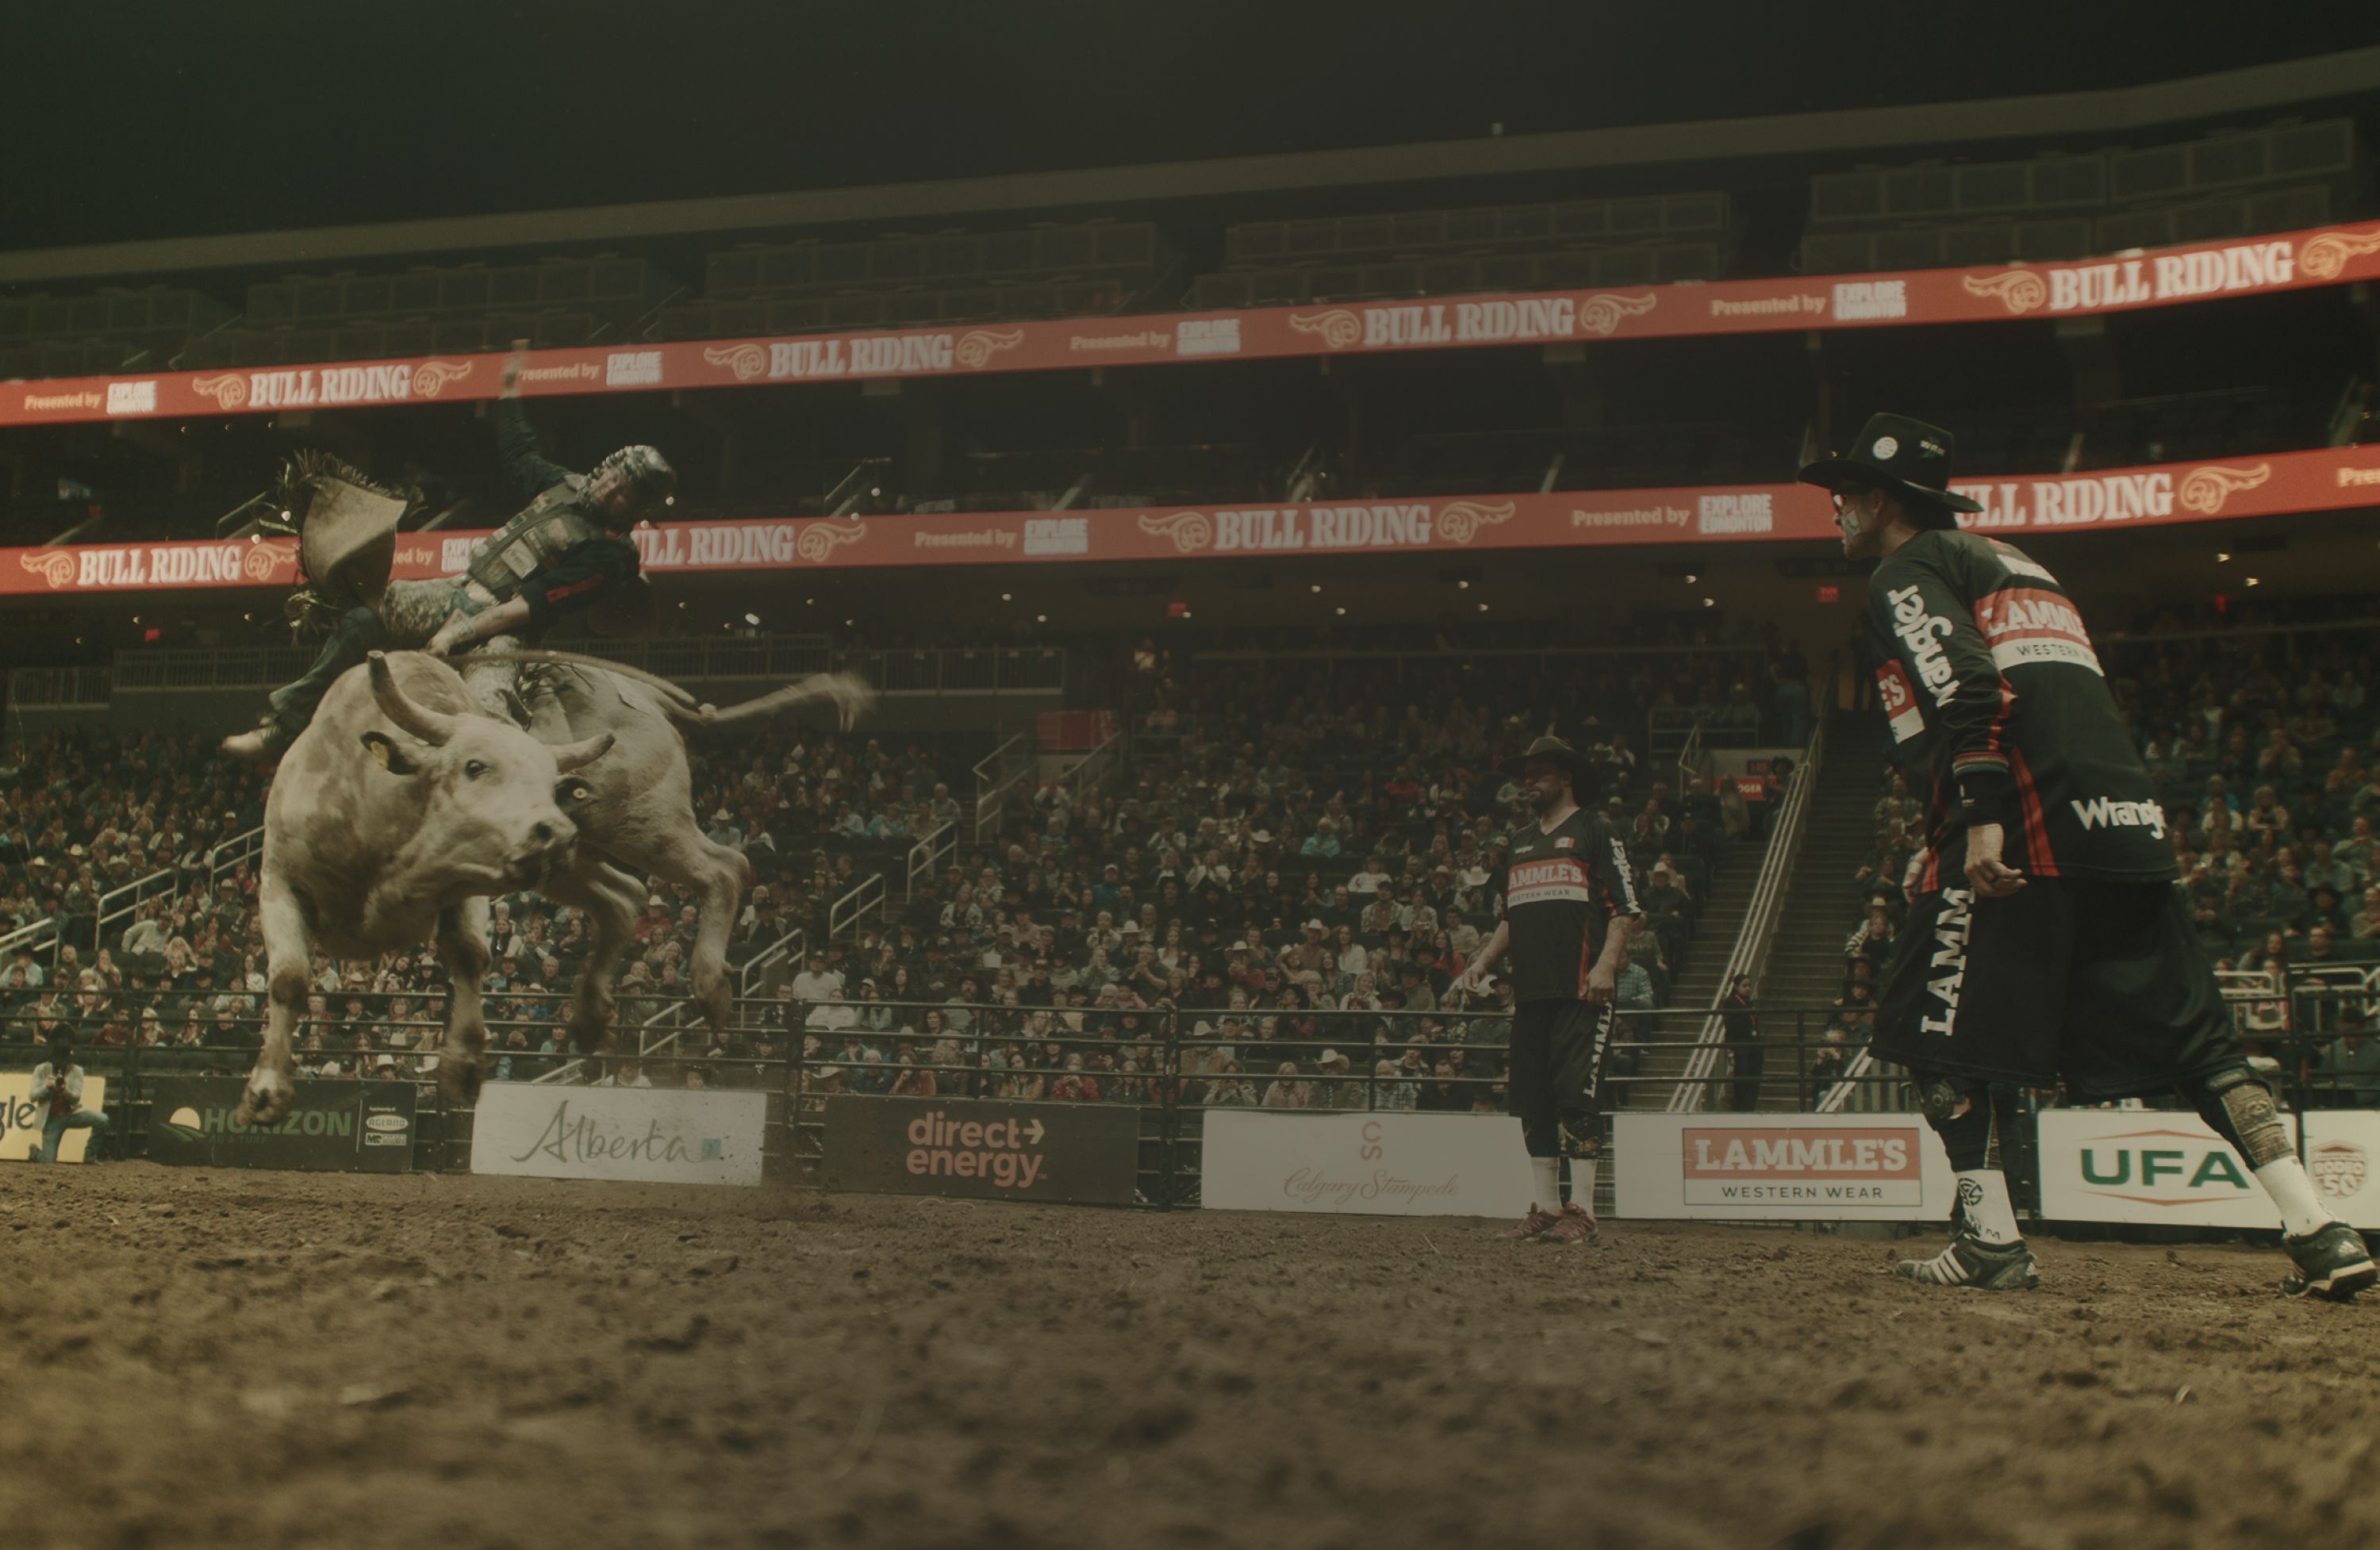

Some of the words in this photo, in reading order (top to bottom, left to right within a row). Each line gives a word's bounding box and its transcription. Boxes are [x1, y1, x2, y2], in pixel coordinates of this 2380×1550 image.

[2049, 258, 2150, 311] BULL
[2155, 243, 2294, 297] RIDING
[1361, 305, 1450, 347] BULL
[1454, 298, 1577, 340] RIDING
[1711, 294, 1798, 316] Presented
[1802, 294, 1826, 315] by
[767, 340, 849, 378] BULL
[850, 334, 954, 374] RIDING
[1069, 332, 1146, 350] Presented
[1149, 331, 1171, 349] by
[582, 362, 600, 380] by
[607, 351, 662, 370] EXPLORE
[25, 392, 83, 411] Presented
[84, 391, 102, 409] by
[248, 370, 317, 409] BULL
[318, 366, 414, 406] RIDING
[1572, 507, 1663, 527] Presented
[1665, 506, 1690, 528] by
[1699, 493, 1772, 516] EXPLORE
[1948, 483, 2027, 529] ULL
[2033, 473, 2175, 526] RIDING
[914, 528, 993, 547] Presented
[994, 528, 1017, 548] by
[1212, 509, 1304, 552] BULL
[1309, 505, 1431, 549] RIDING
[1699, 513, 1772, 534] EDMONTON
[416, 548, 434, 566] by
[630, 528, 685, 566] ULL
[688, 525, 794, 566] RIDING
[77, 549, 146, 585] BULL
[149, 545, 241, 583] RIDING
[1887, 585, 1962, 710] Wrangler
[1738, 783, 1762, 793] OGER
[1510, 863, 1583, 888] AMMLE'S
[1510, 891, 1541, 903] ESTERN
[1920, 887, 1975, 1036] LAMM
[1583, 1001, 1613, 1099] LAMML
[510, 1099, 703, 1164] Alberta
[908, 1111, 1021, 1149] direct
[906, 1149, 1043, 1188] energy
[1695, 1138, 1908, 1172] LAMMLE'S
[2080, 1149, 2251, 1190] UFA
[1284, 1167, 1359, 1205] Calgary
[1360, 1168, 1460, 1205] Stampede
[1722, 1186, 1817, 1199] WESTERN
[1826, 1187, 1884, 1199] WEAR
